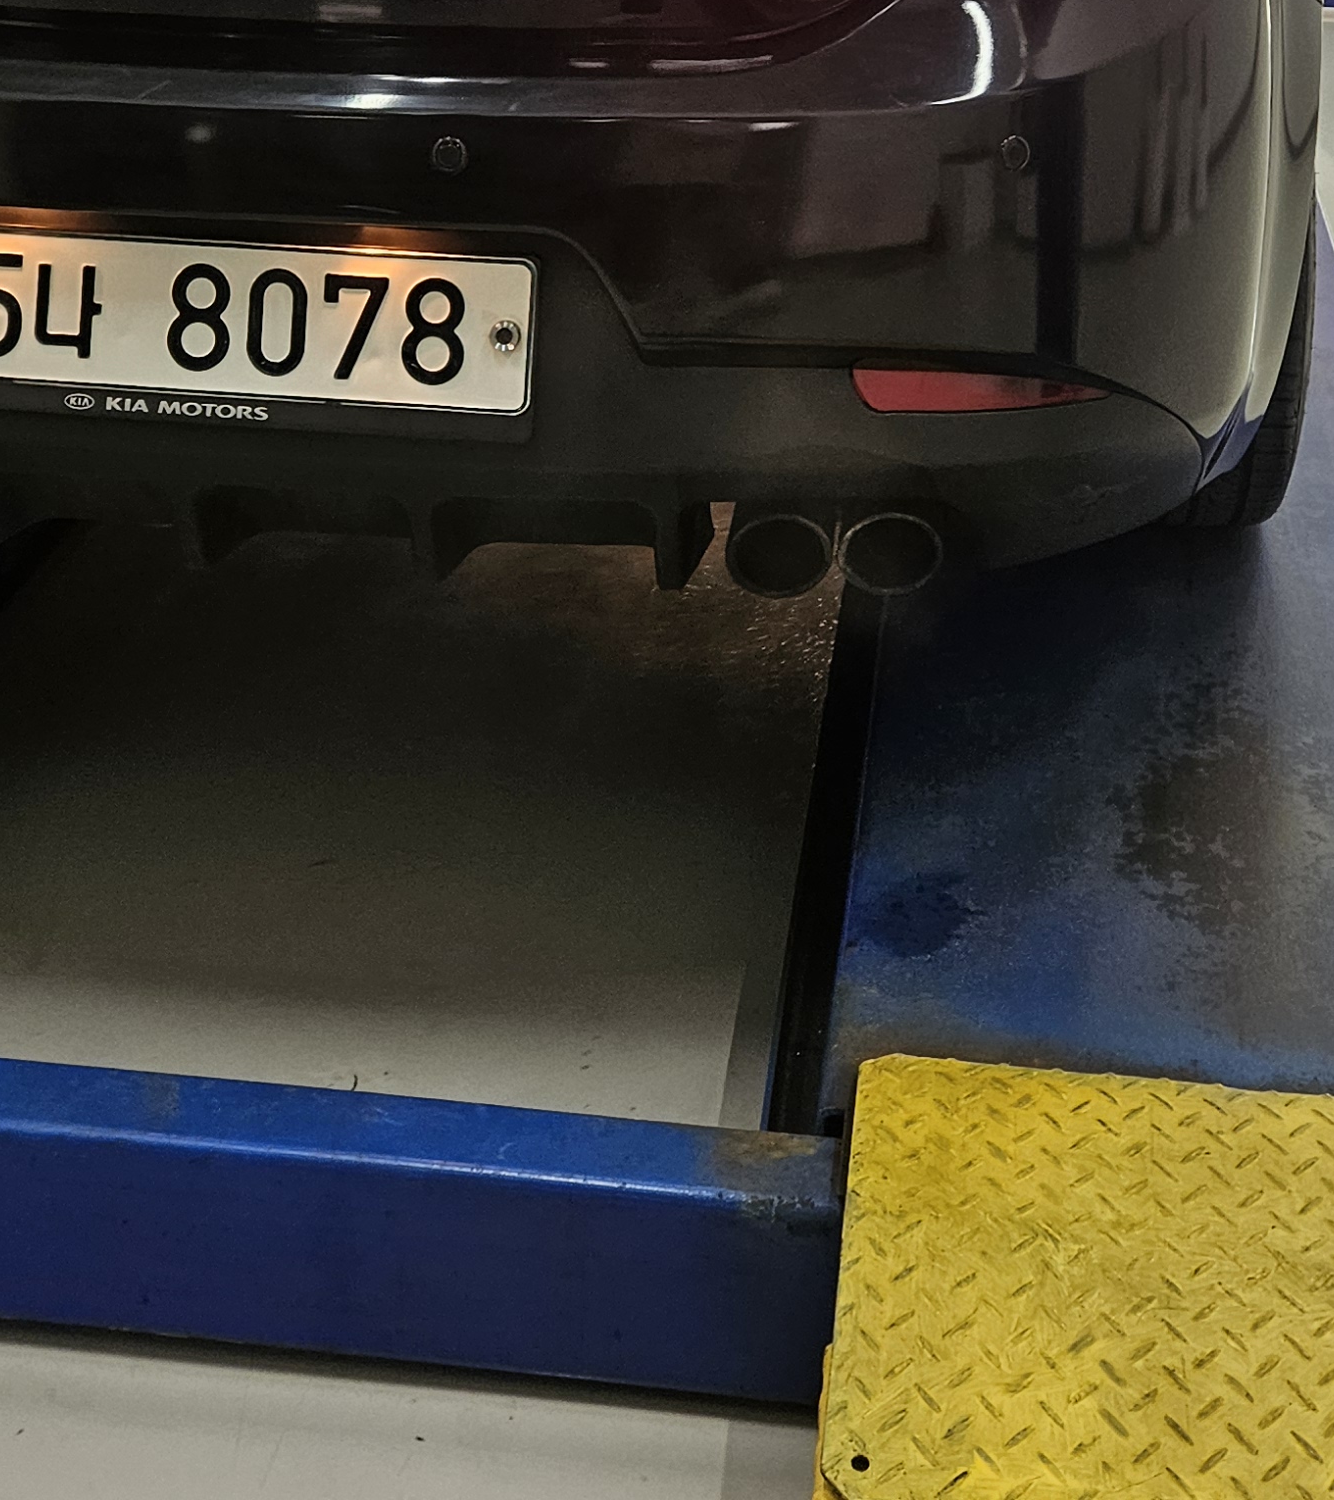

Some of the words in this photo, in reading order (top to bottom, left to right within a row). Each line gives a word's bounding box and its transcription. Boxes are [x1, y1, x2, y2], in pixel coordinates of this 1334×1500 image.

[166, 262, 466, 387] 8078
[67, 395, 92, 408] KIA
[105, 396, 149, 413] KIA
[157, 400, 269, 421] MOTORS
